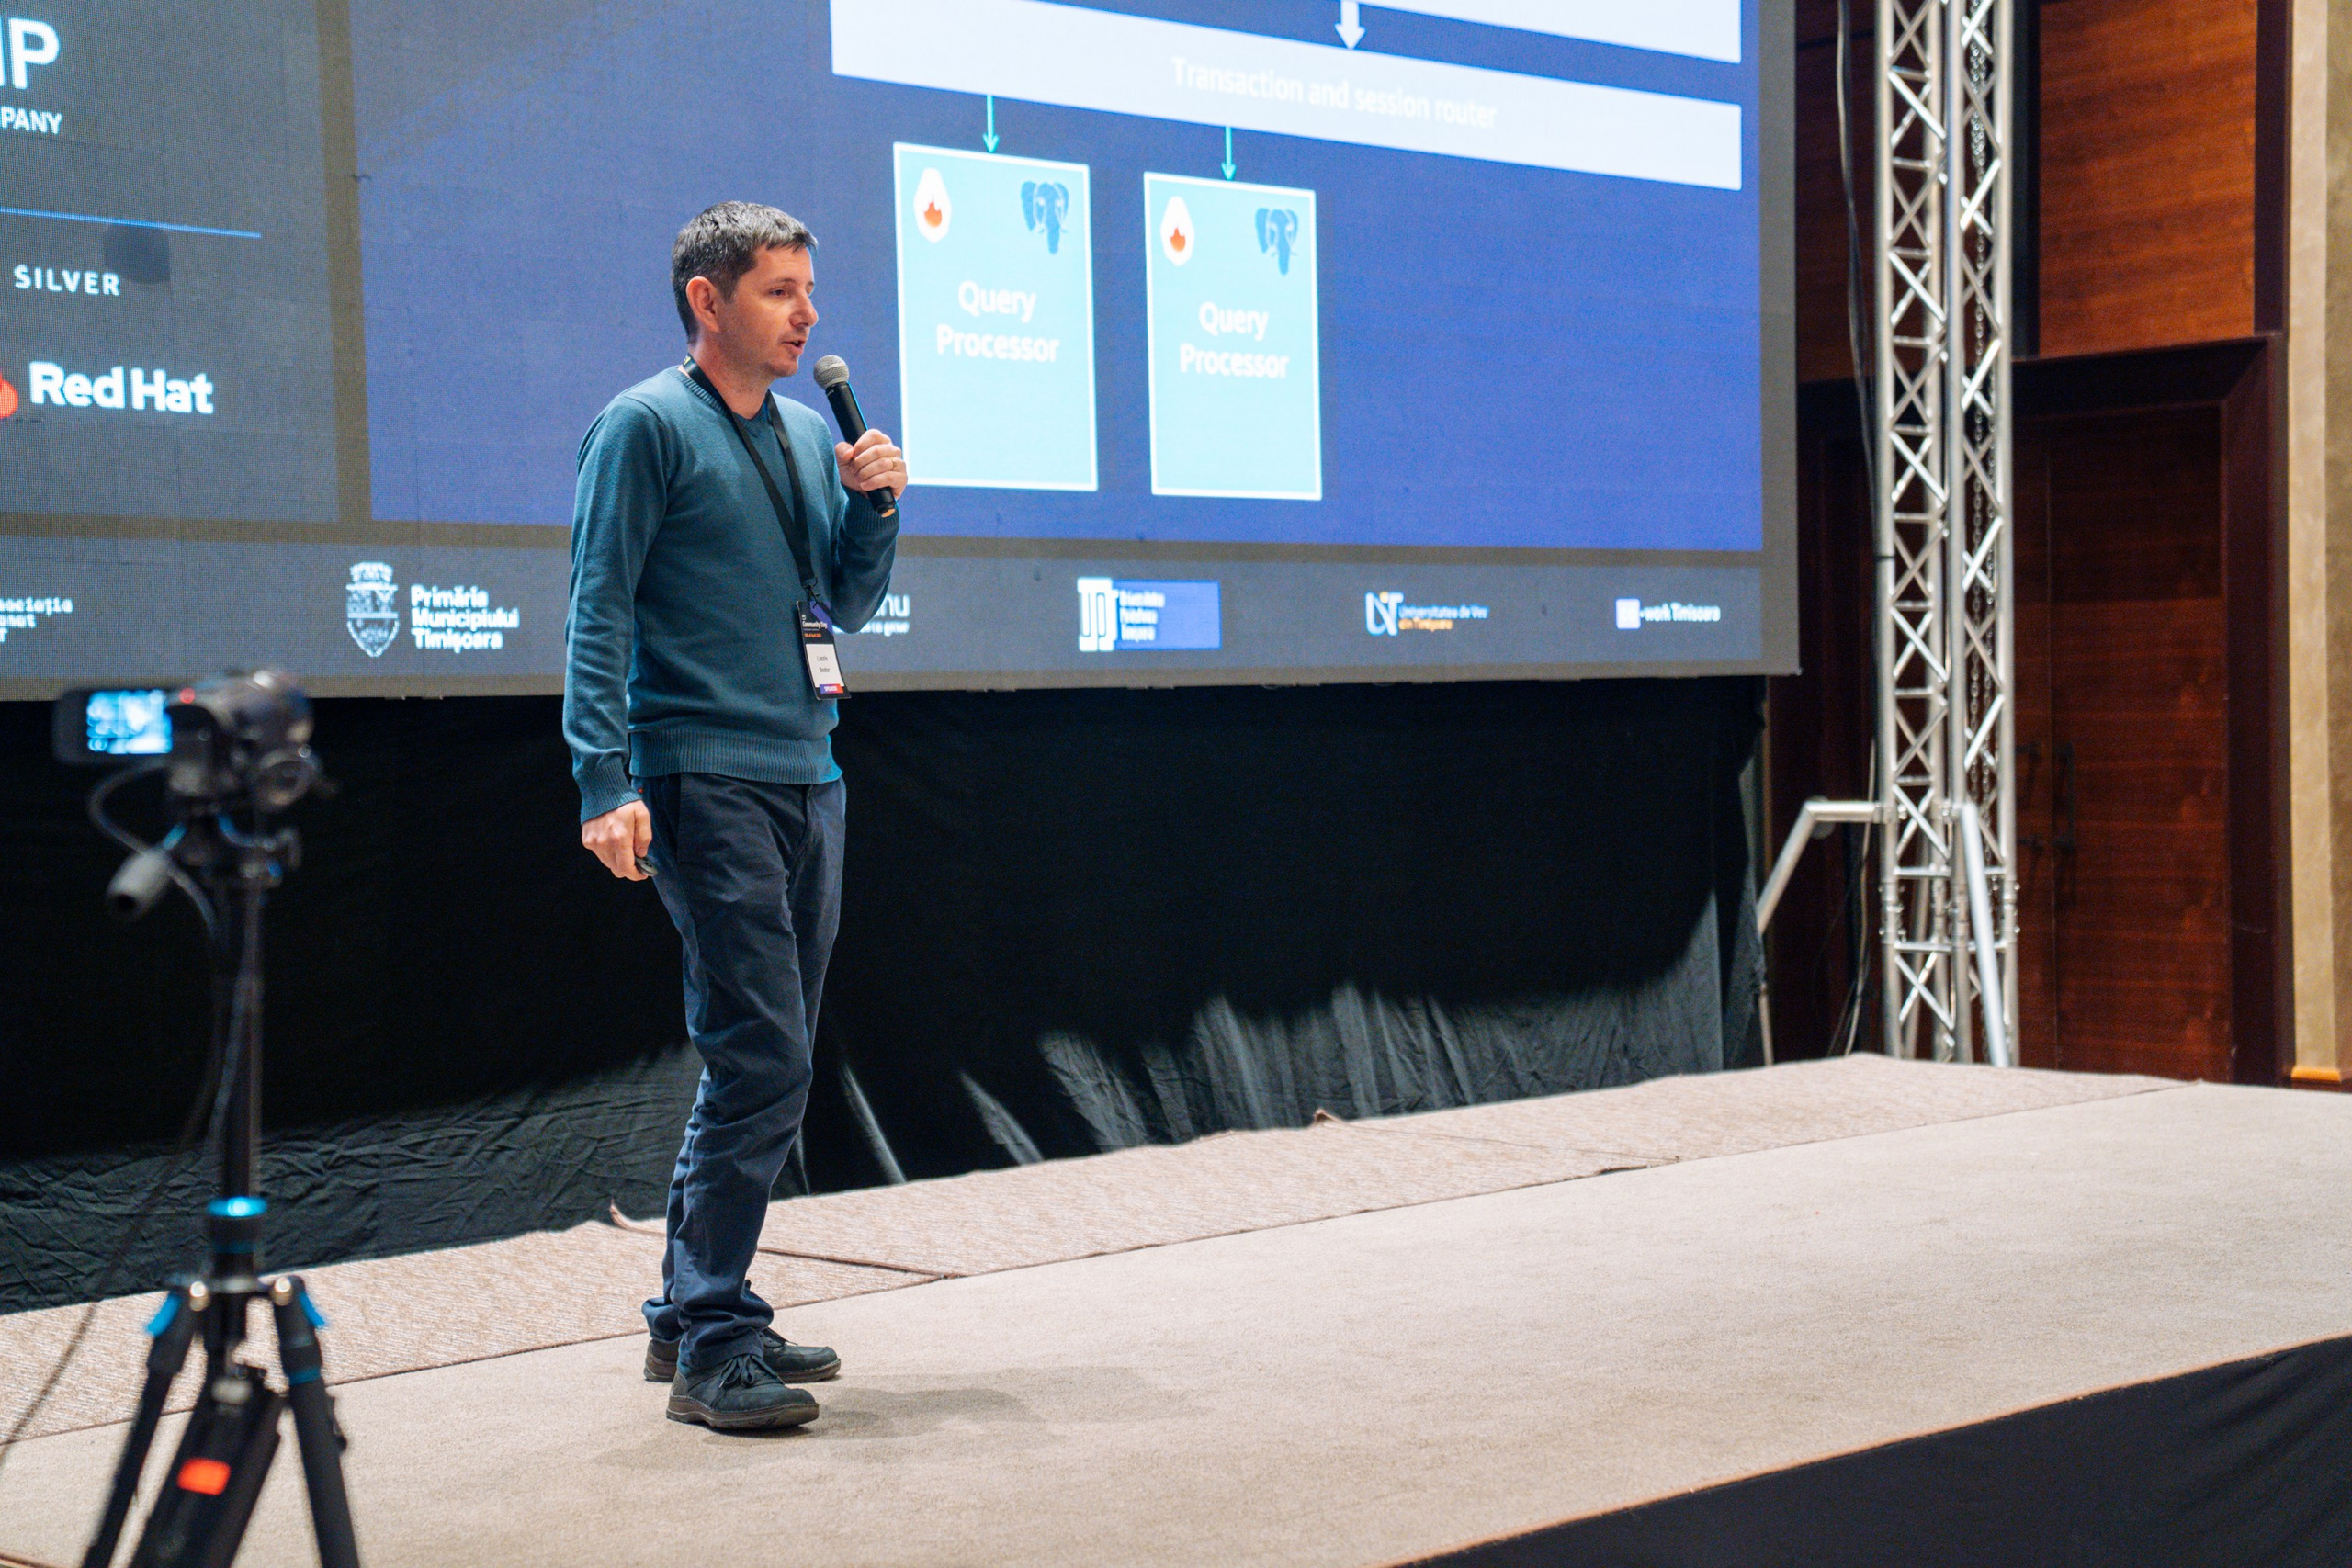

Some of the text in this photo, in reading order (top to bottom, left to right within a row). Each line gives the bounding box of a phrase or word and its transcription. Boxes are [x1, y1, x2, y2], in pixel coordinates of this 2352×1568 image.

[1170, 55, 1498, 130] Transaction and session router
[14, 264, 120, 296] SILVER
[958, 280, 1036, 323] Query
[1199, 302, 1269, 342] Query
[936, 324, 1060, 363] Processor
[1180, 343, 1289, 379] Processor
[29, 360, 214, 414] Red Hat
[411, 607, 520, 632] Municipiului
